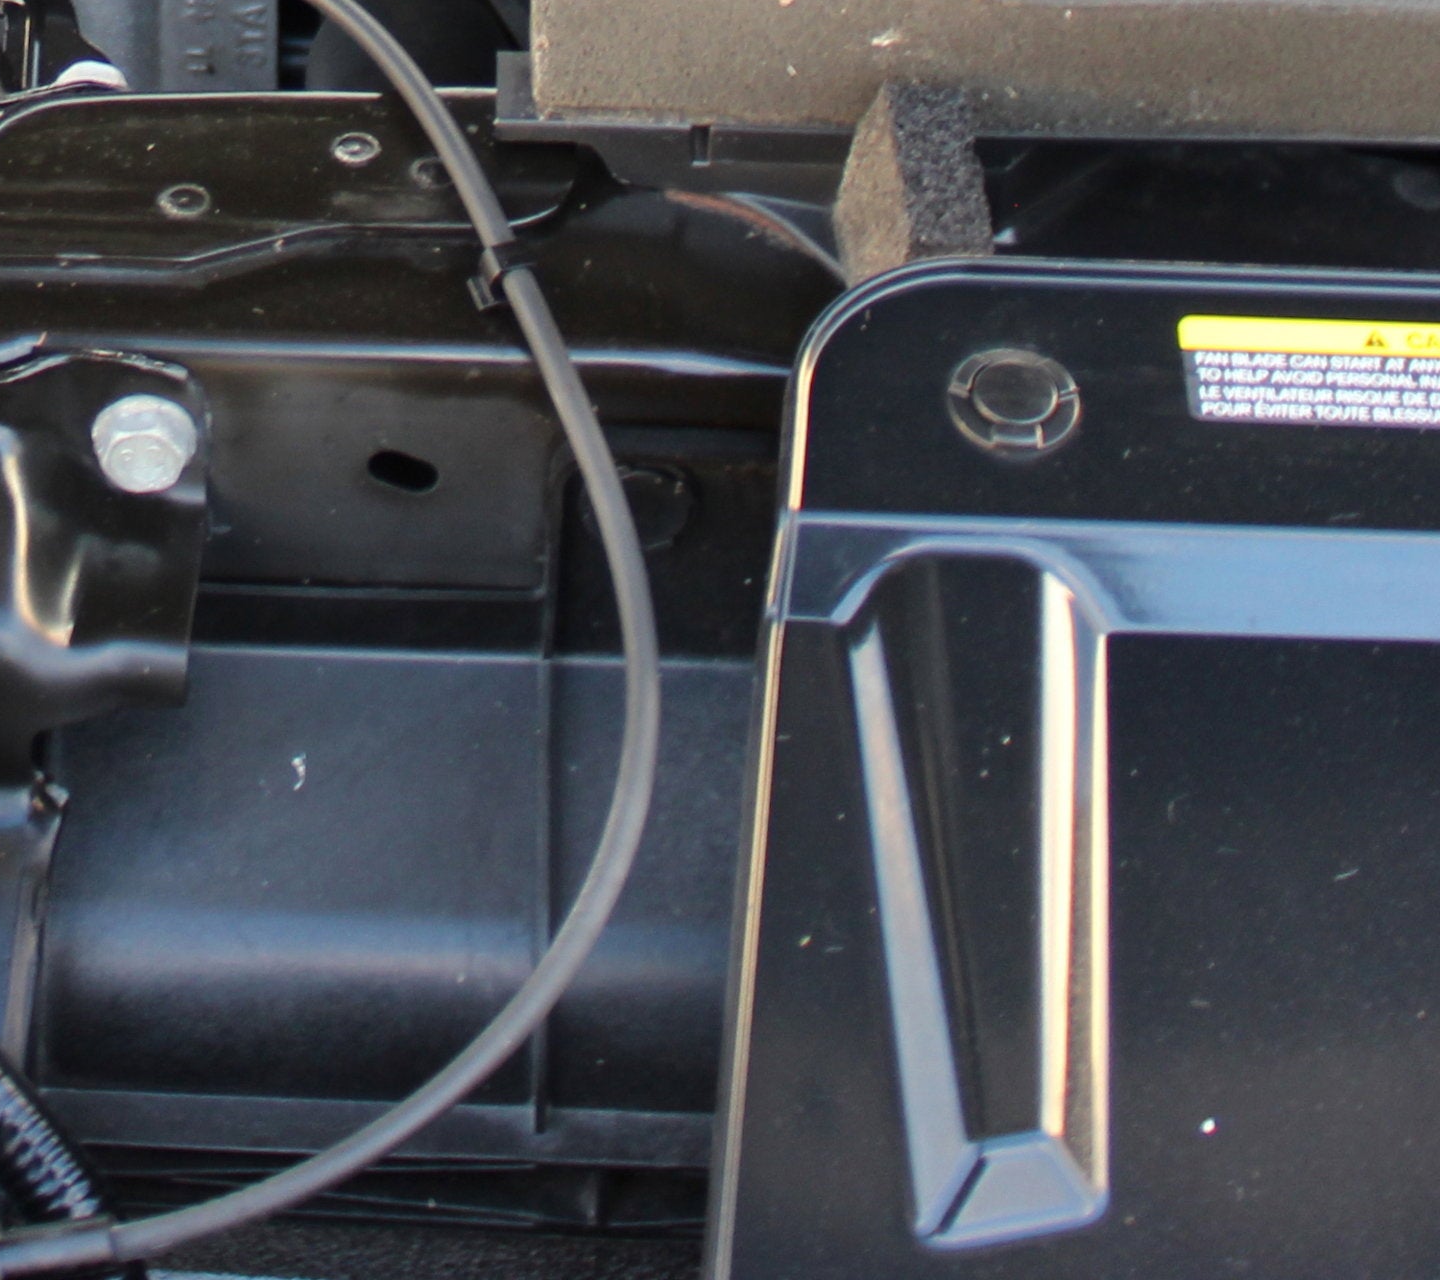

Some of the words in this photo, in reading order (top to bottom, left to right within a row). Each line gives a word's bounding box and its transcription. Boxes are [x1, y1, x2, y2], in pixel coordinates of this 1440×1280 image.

[1195, 352, 1228, 367] FAN
[1231, 353, 1288, 368] BLADE
[1290, 355, 1328, 370] CAN
[1331, 356, 1381, 371] START
[1385, 357, 1406, 372] AT
[1197, 368, 1221, 382] TO
[1224, 369, 1270, 384] HELP
[1272, 369, 1324, 385] AVOID
[1326, 371, 1417, 389] PERSONAL
[1199, 385, 1221, 400] LE
[1224, 386, 1334, 404] VENTILATEUR
[1335, 389, 1400, 406] RISQUE
[1403, 391, 1426, 407] DE
[1201, 402, 1252, 417] POUR
[1255, 399, 1312, 419] ÉVITER
[1315, 404, 1370, 421] TOUTE
